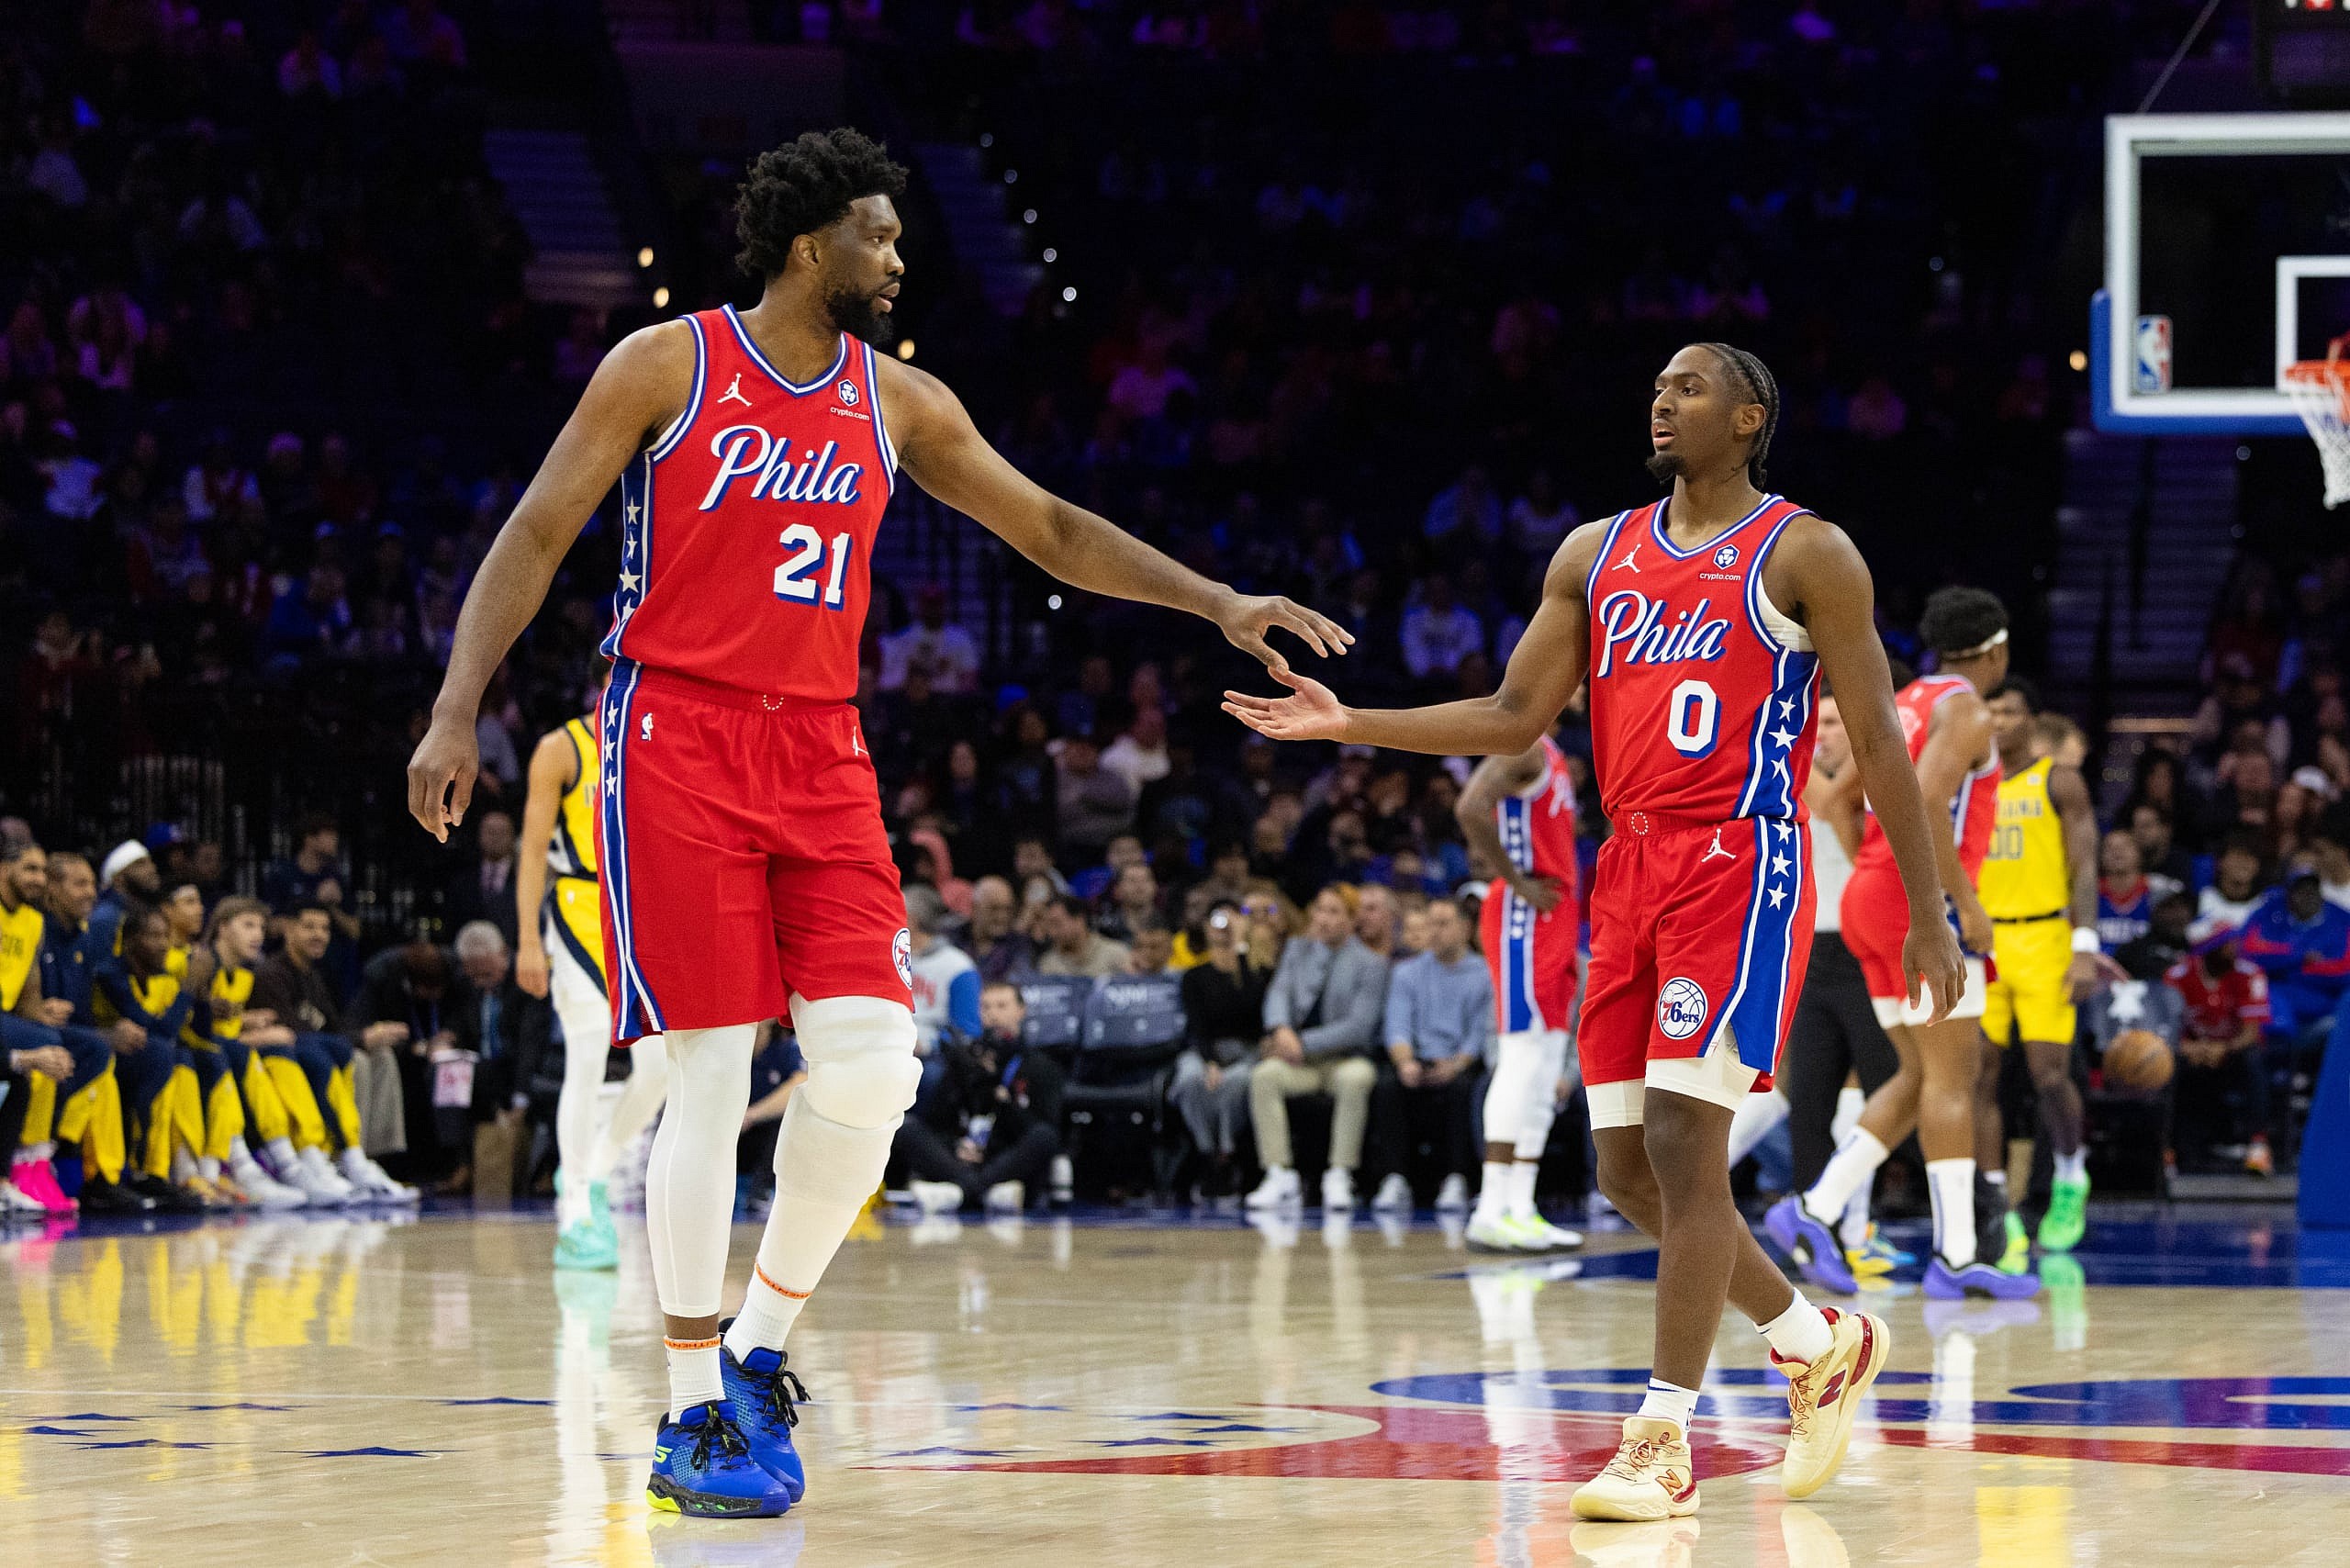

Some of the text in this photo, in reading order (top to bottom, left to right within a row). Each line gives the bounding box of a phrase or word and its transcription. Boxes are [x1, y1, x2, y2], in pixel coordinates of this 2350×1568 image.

[830, 406, 870, 421] crypto.com
[699, 425, 863, 511] Phila
[774, 523, 852, 608] 21
[1699, 572, 1741, 581] crypto.com
[1597, 590, 1730, 678] Phila
[1667, 679, 1720, 756] 0
[1662, 1001, 1700, 1024] 76ers
